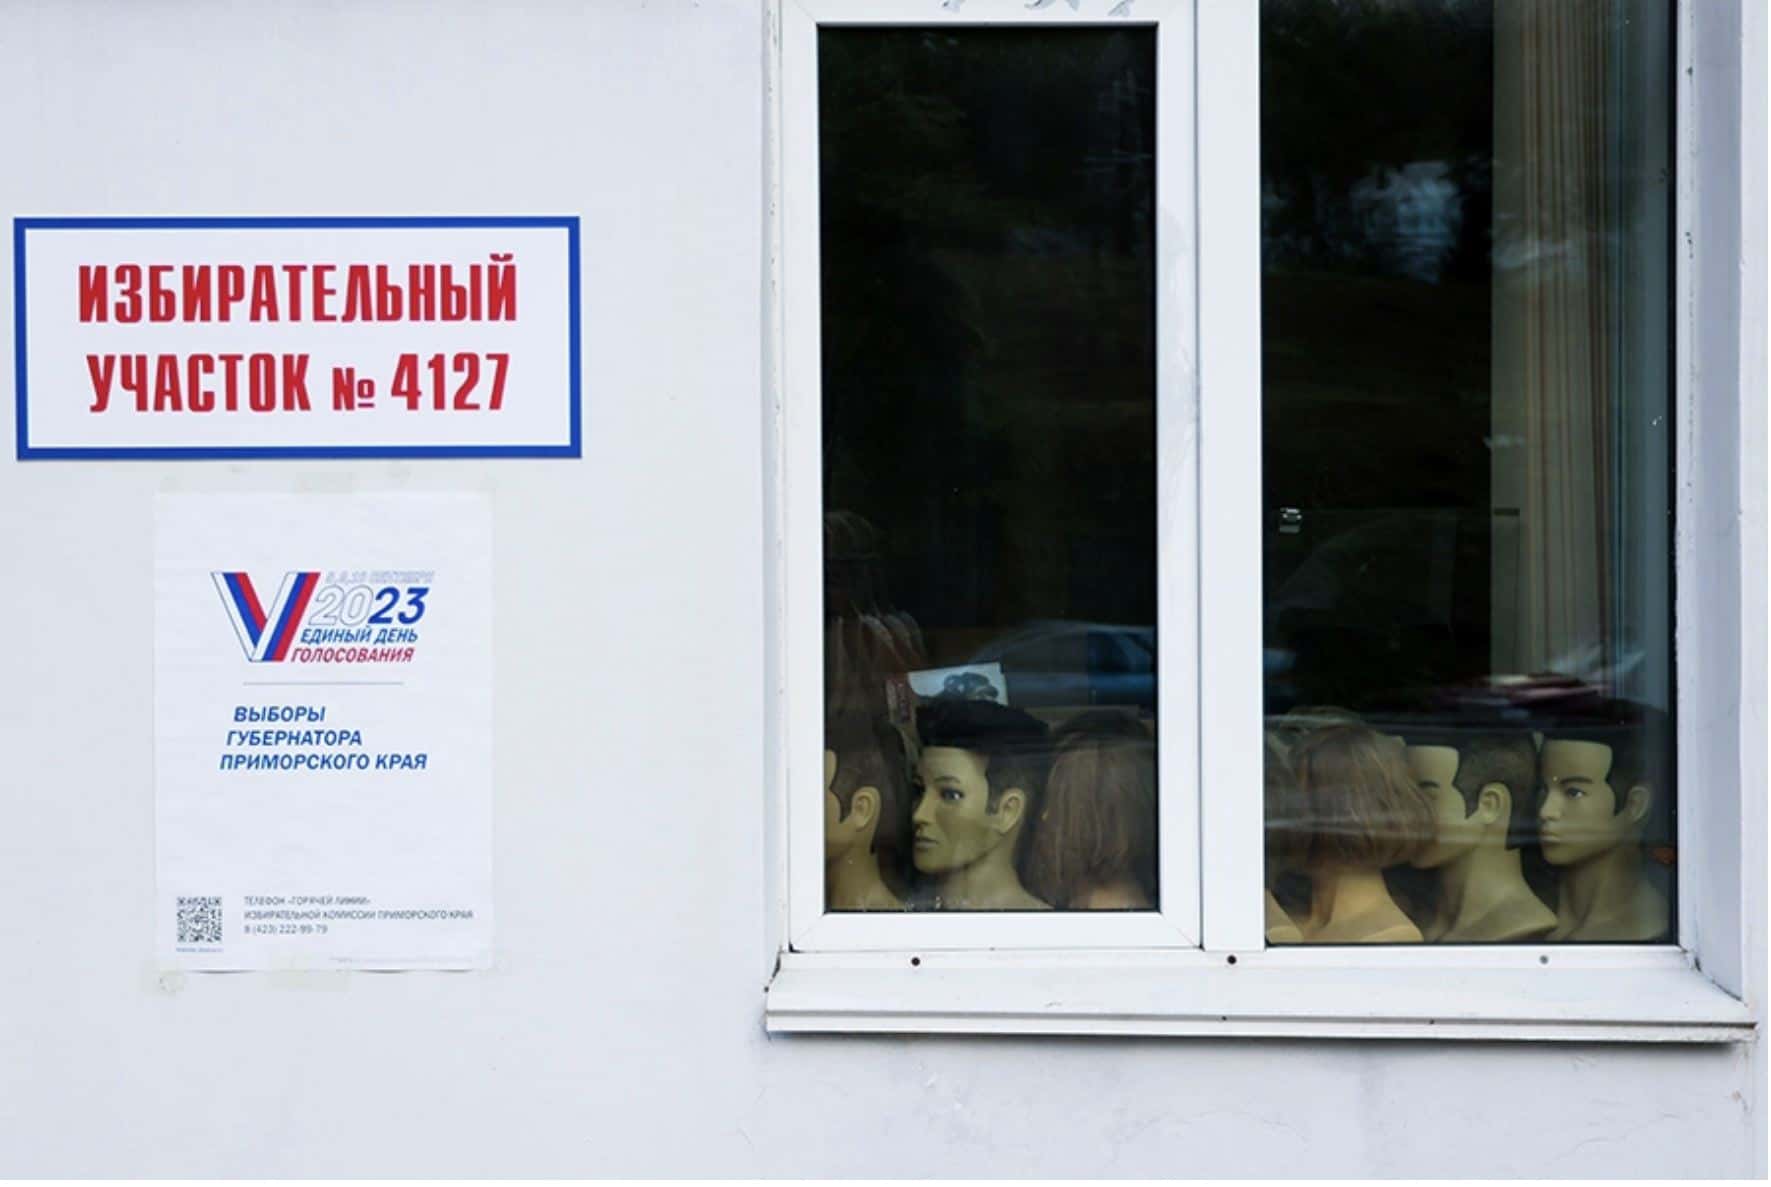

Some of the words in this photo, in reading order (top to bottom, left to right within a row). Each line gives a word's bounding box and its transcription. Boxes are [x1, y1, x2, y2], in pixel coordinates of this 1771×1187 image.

[78, 253, 517, 322] ИЗБИРАТЕЛЬНЫЙ
[87, 353, 311, 412] УЧАСТОК
[332, 367, 375, 410] №
[391, 353, 510, 410] 4127
[308, 584, 429, 626] 2023
[300, 626, 372, 645] ЕДИНЫЙ
[374, 629, 419, 645] ДЕНЬ
[291, 647, 414, 663] ГОЛОСОВАНИЯ
[234, 706, 326, 723] ВЫБОРЫ
[226, 730, 363, 747] ГУБЕРНАТОРА
[219, 753, 370, 770] ПРИМОРСКОГО
[375, 753, 428, 770] КРАЯ
